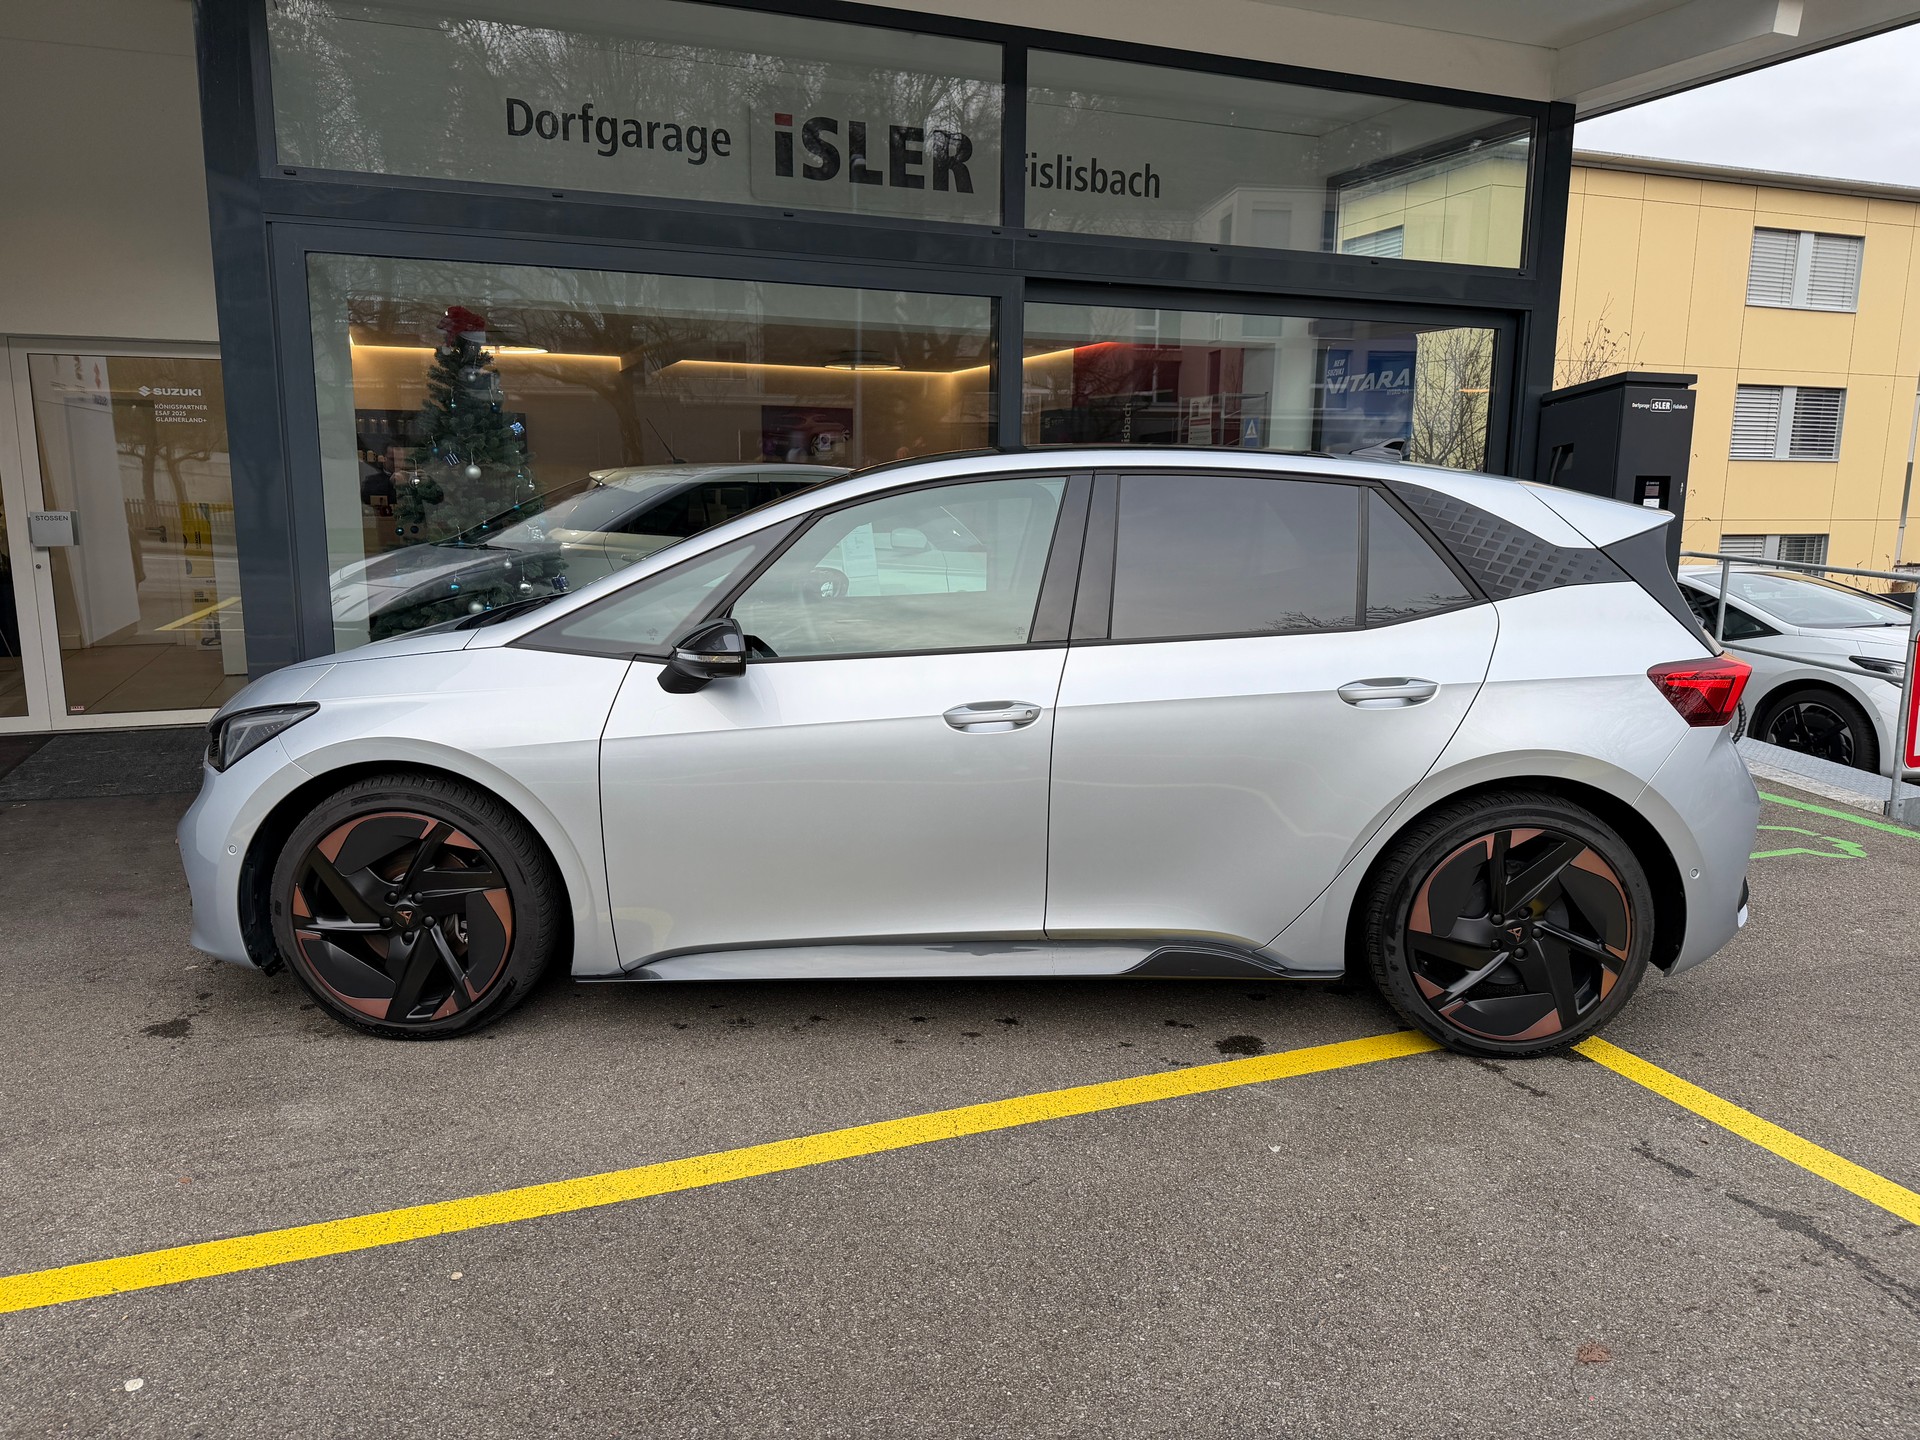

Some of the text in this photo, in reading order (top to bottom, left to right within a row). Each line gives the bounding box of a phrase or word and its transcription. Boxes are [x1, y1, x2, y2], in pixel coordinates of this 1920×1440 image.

[506, 97, 1160, 198] Dorfgarage iSLER islisbach
[1333, 359, 1346, 367] NEW
[1327, 367, 1345, 377] SUZUKI
[1326, 367, 1410, 394] VITARA
[152, 387, 202, 397] SUZUKI
[154, 403, 208, 411] KÖNIGSPARTNER
